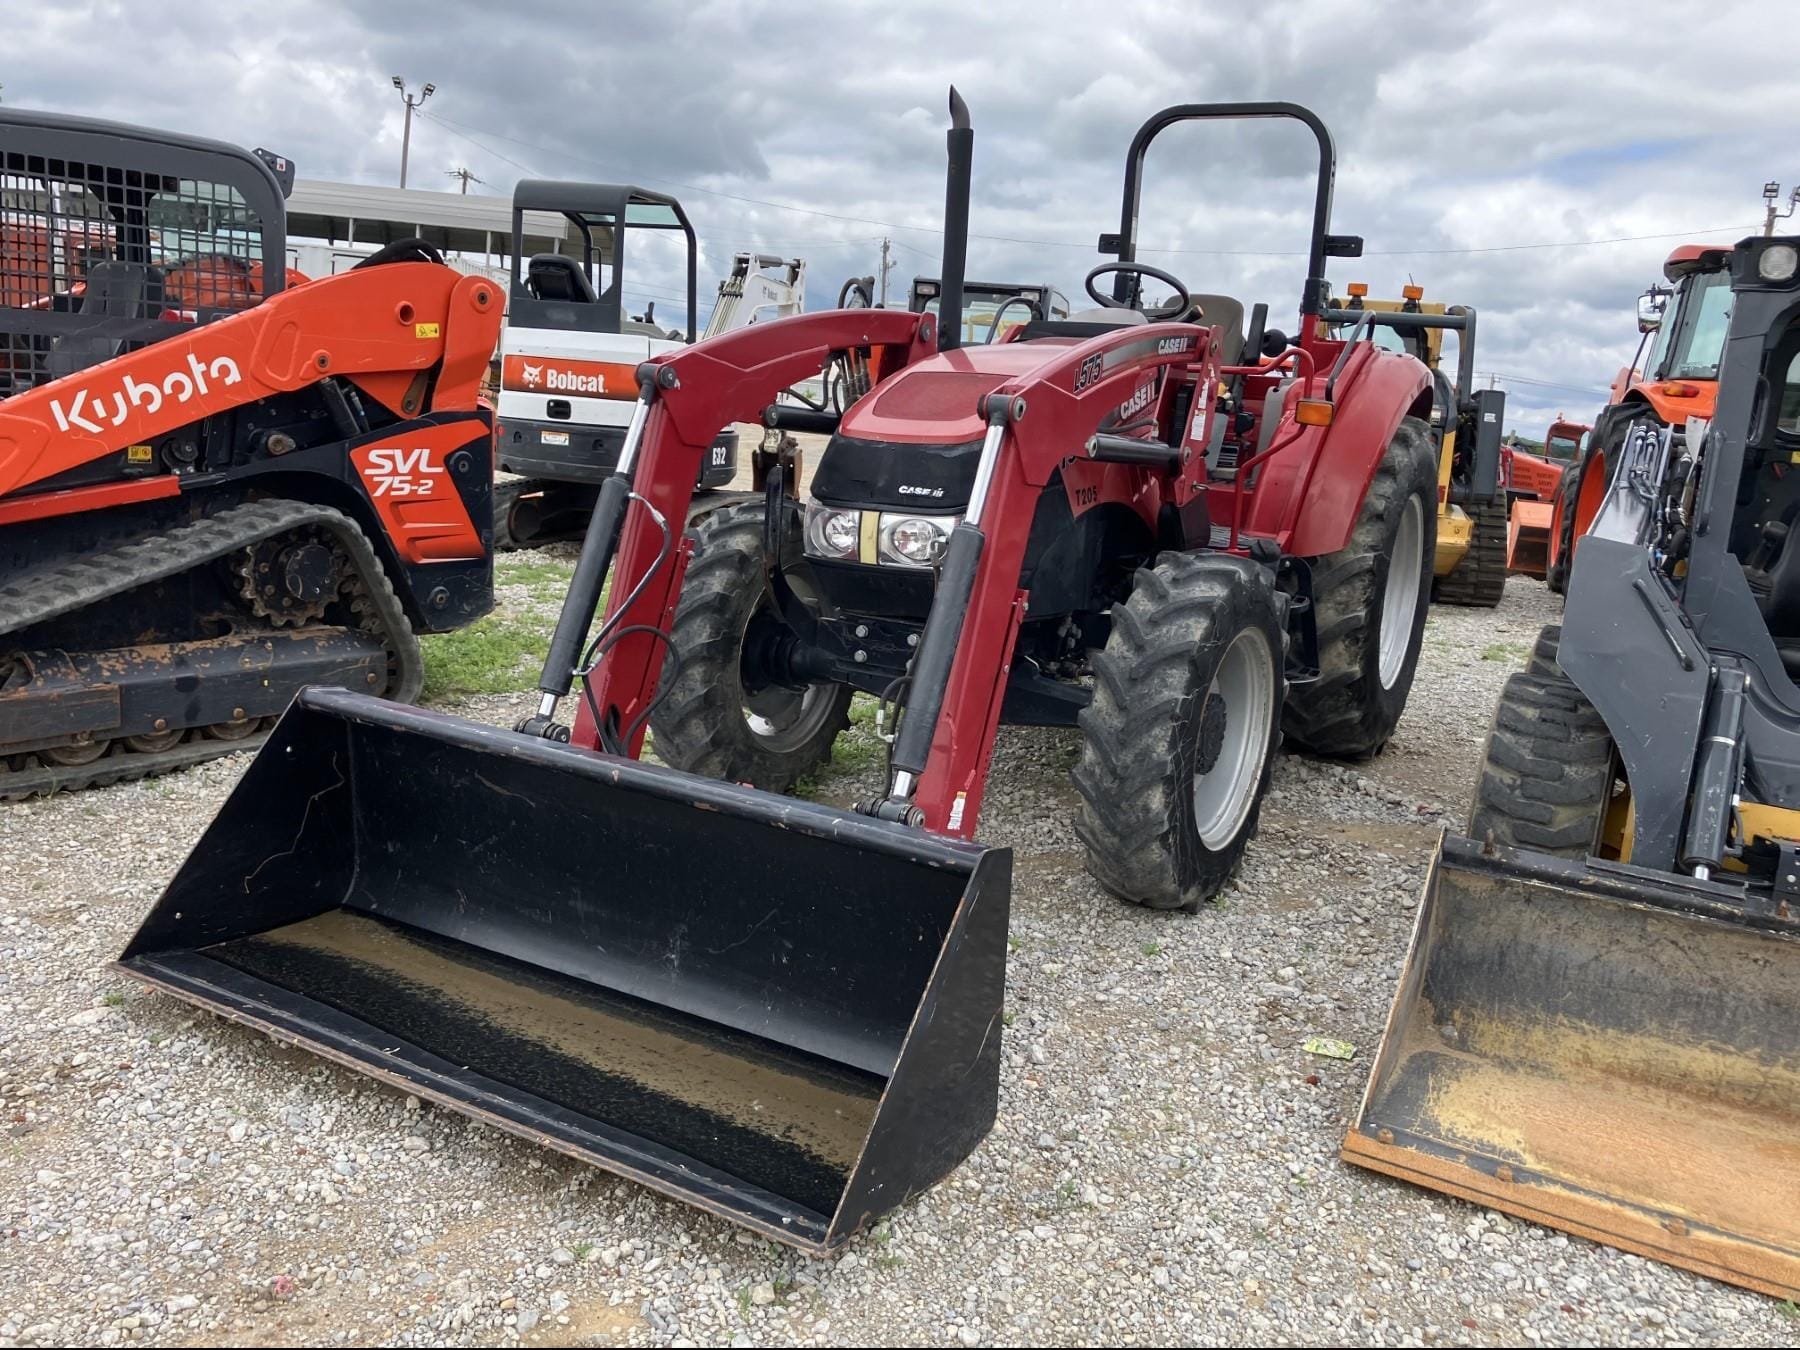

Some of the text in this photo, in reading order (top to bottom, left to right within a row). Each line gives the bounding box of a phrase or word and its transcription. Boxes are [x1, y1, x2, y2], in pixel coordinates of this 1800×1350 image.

[546, 368, 605, 393] Bobcat
[50, 353, 242, 433] Kubota
[1120, 386, 1147, 420] CASE
[364, 448, 444, 475] SVL
[712, 446, 726, 466] E32
[372, 475, 434, 496] 75-2
[898, 485, 932, 496] CASE
[1075, 485, 1097, 507] T205
